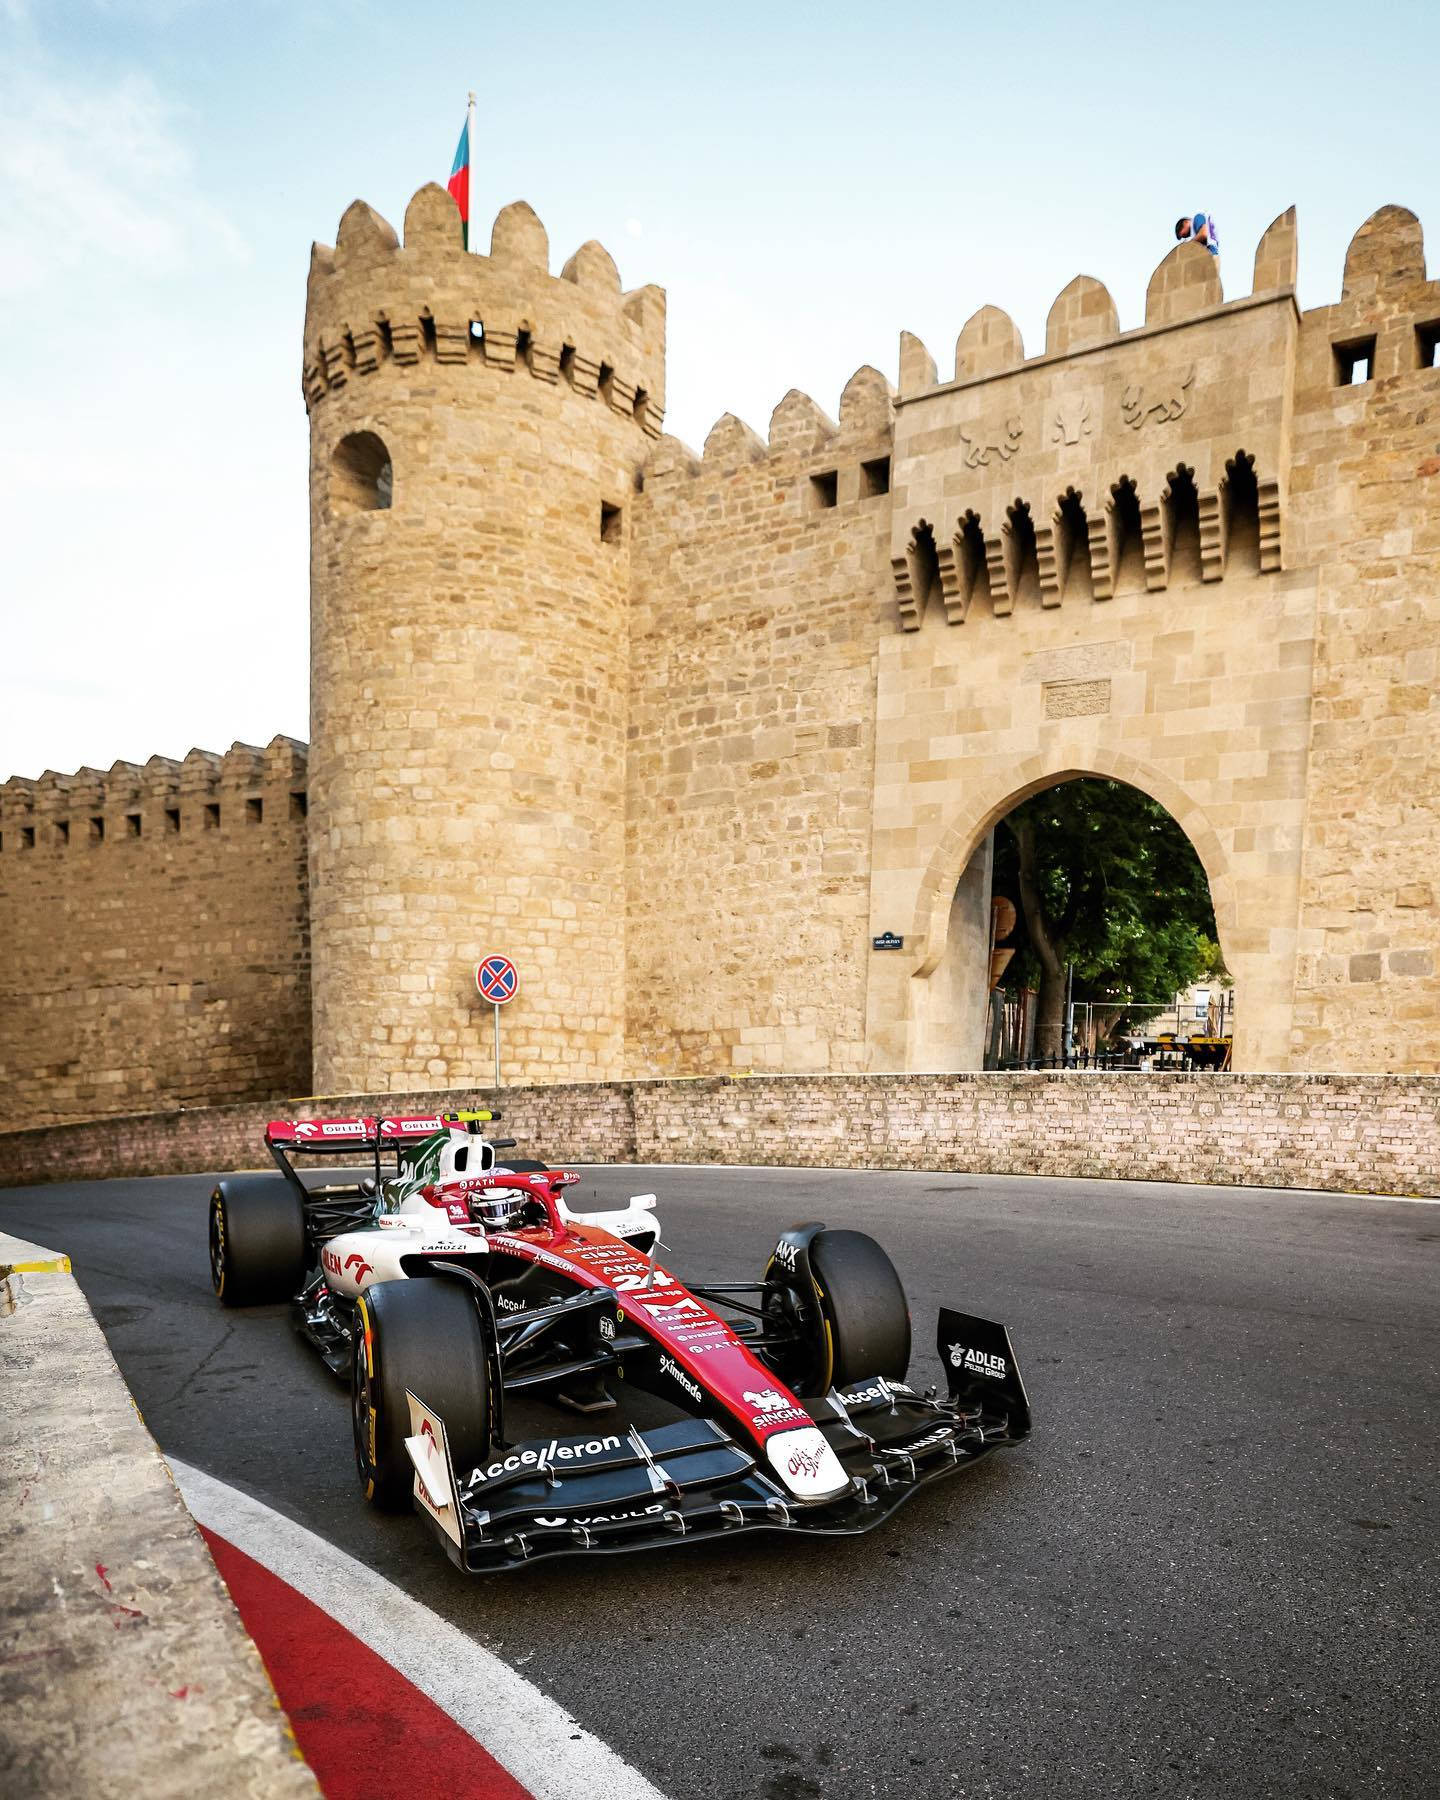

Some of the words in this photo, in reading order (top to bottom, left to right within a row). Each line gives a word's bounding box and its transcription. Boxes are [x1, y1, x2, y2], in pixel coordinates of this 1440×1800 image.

[469, 1179, 495, 1188] PATH
[775, 1240, 801, 1266] AMX
[611, 1271, 675, 1292] 24
[655, 1310, 710, 1323] MARELLI
[600, 1318, 615, 1337] FIA
[703, 1340, 743, 1351] PATH
[964, 1361, 985, 1374] PELZER
[984, 1367, 1006, 1380] GROUP
[965, 1348, 1006, 1372] ADLER
[659, 1354, 703, 1403] aximtrade
[752, 1407, 809, 1428] SINGHA
[467, 1435, 622, 1488] Accelleron
[572, 1504, 665, 1525] VAULD
